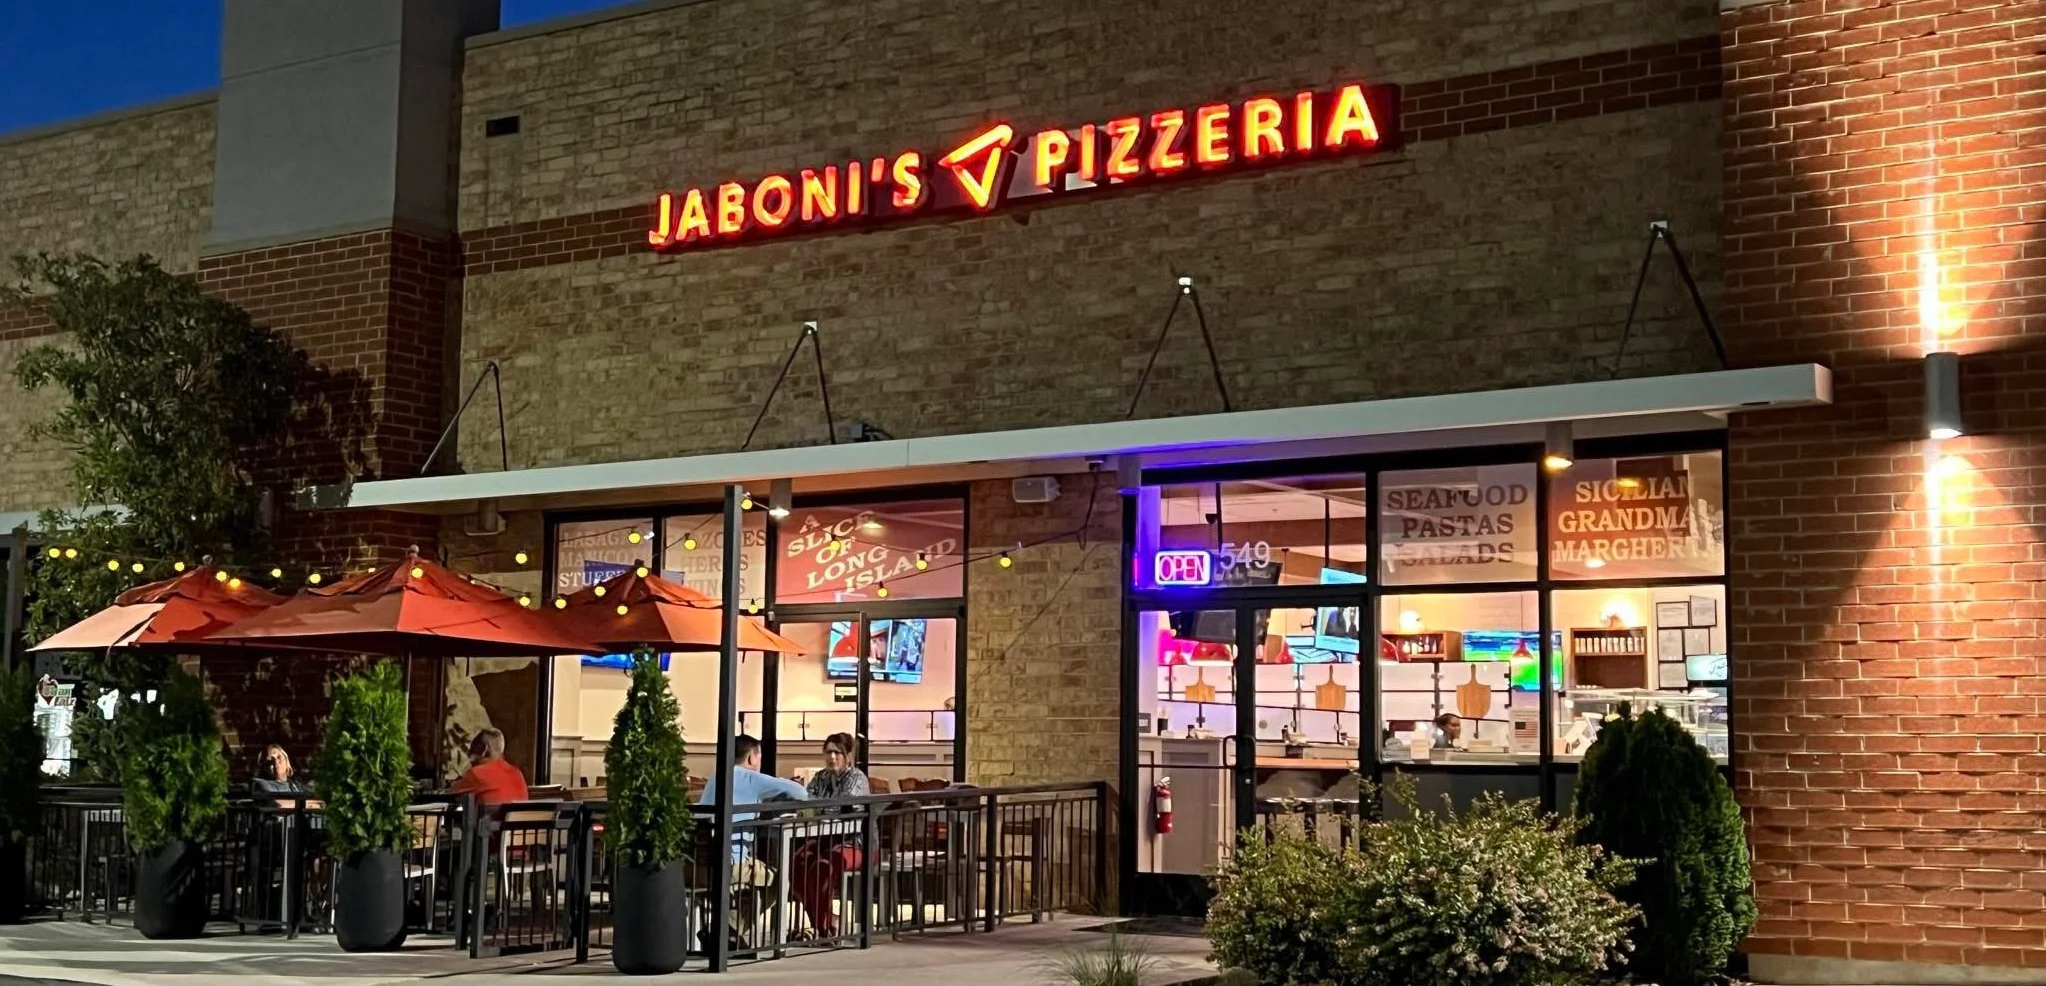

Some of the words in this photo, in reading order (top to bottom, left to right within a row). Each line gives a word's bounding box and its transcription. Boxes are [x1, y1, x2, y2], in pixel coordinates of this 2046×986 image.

[648, 152, 922, 246] JABONI'S
[1034, 84, 1380, 187] PIZZERIA
[1387, 484, 1528, 510] SEAFOOD
[787, 510, 876, 558] SLICE
[800, 514, 821, 533] A
[1401, 513, 1514, 538] PASTAS
[563, 529, 644, 548] LASAG
[815, 536, 856, 564] OF
[807, 544, 889, 590] LONG
[844, 538, 957, 594] ISLAND
[1160, 555, 1206, 581] OPEN
[1219, 541, 1270, 570] 549
[559, 570, 629, 588] STUFF
